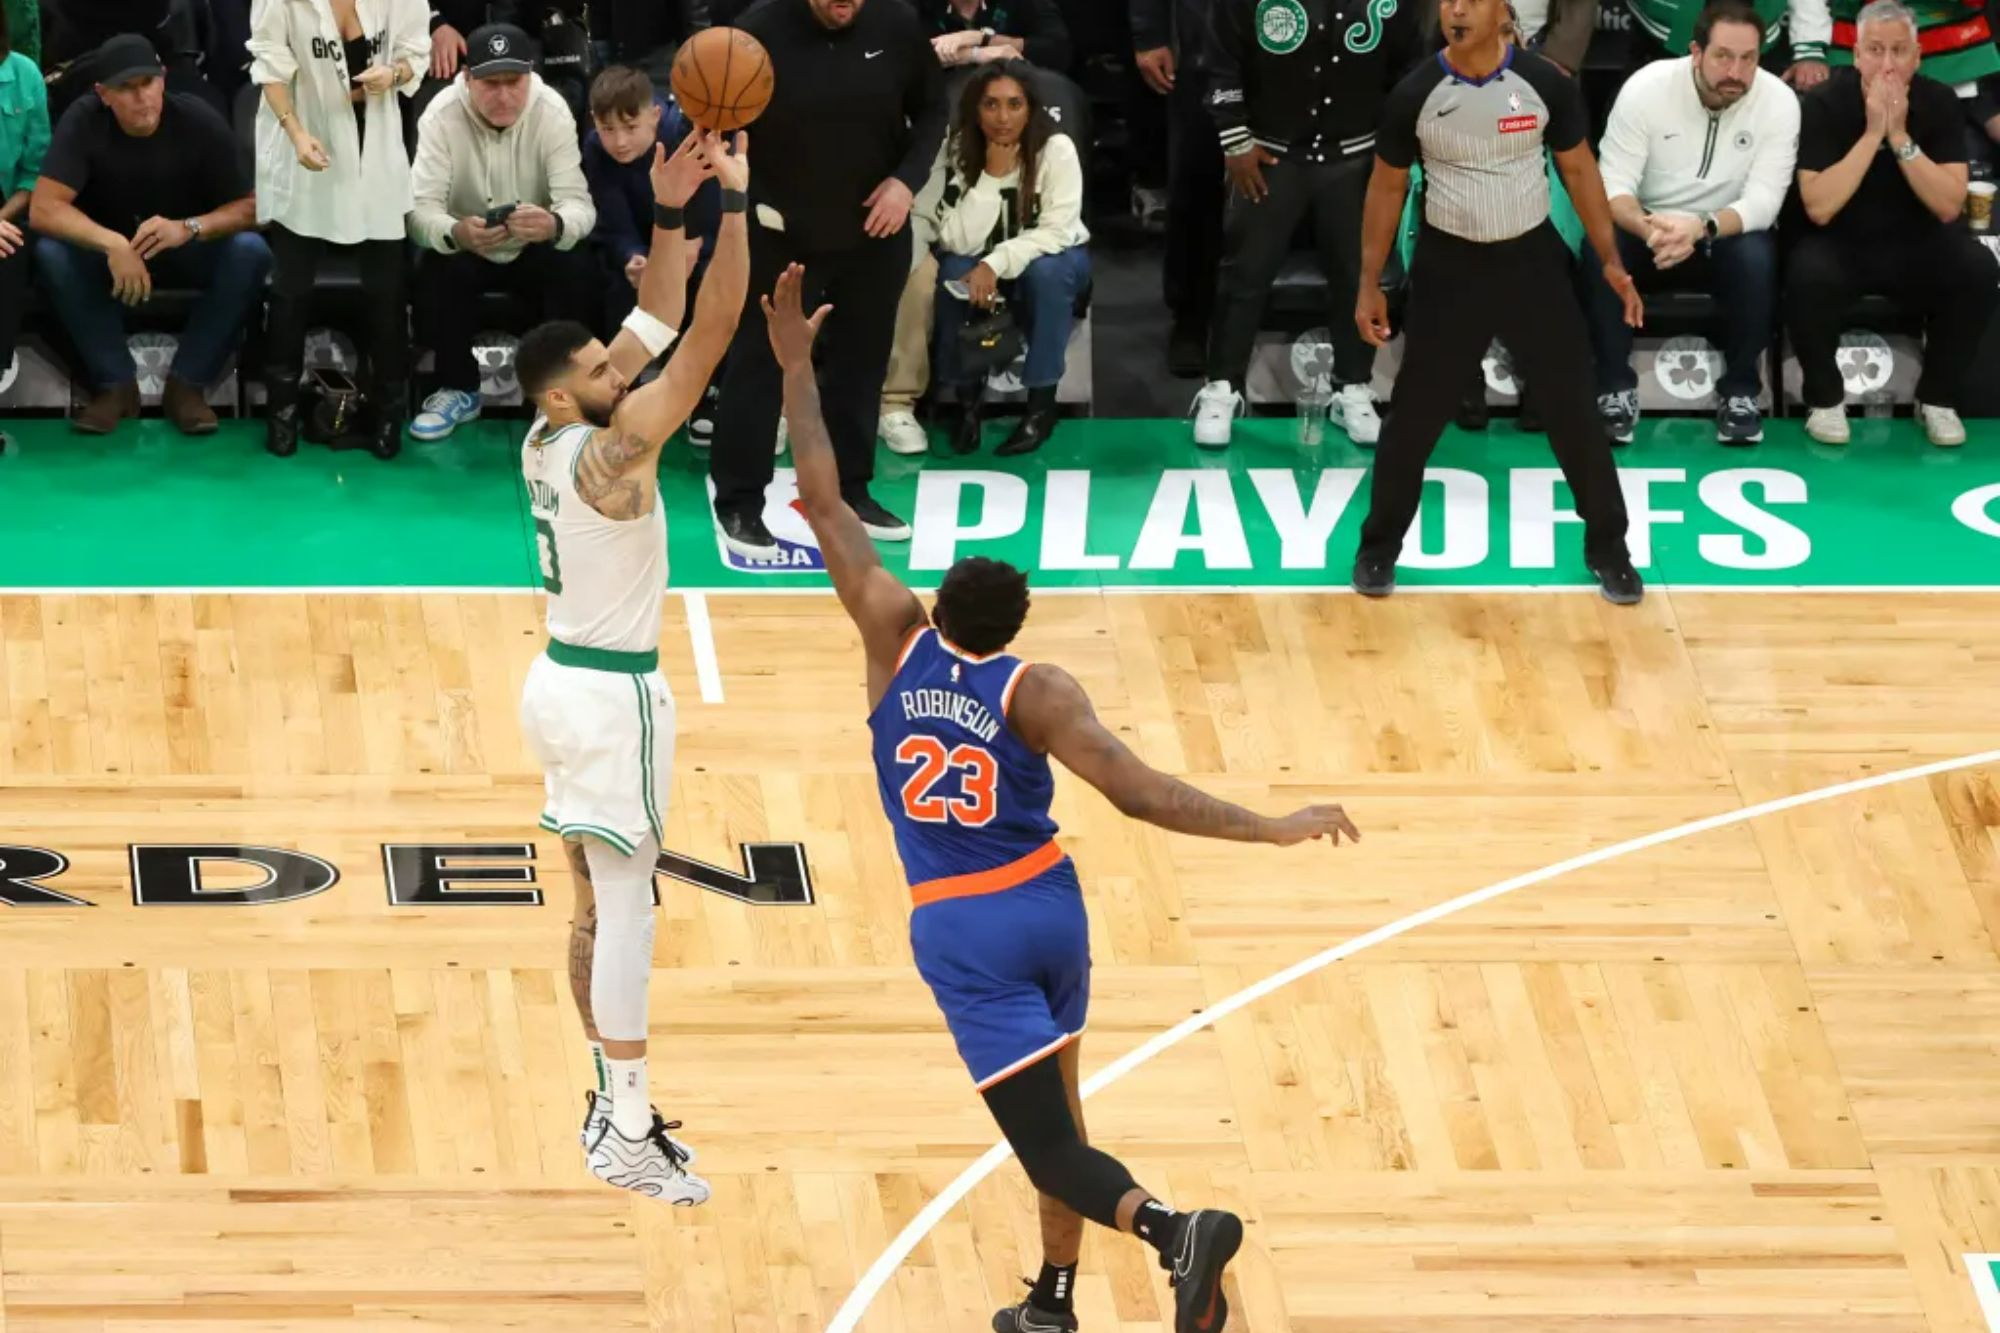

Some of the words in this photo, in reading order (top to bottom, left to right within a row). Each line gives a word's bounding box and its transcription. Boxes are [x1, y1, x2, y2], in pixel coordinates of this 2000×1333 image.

[908, 468, 1811, 570] PLAYOFFS
[900, 688, 1000, 743] ROBINSON
[895, 734, 998, 827] 23
